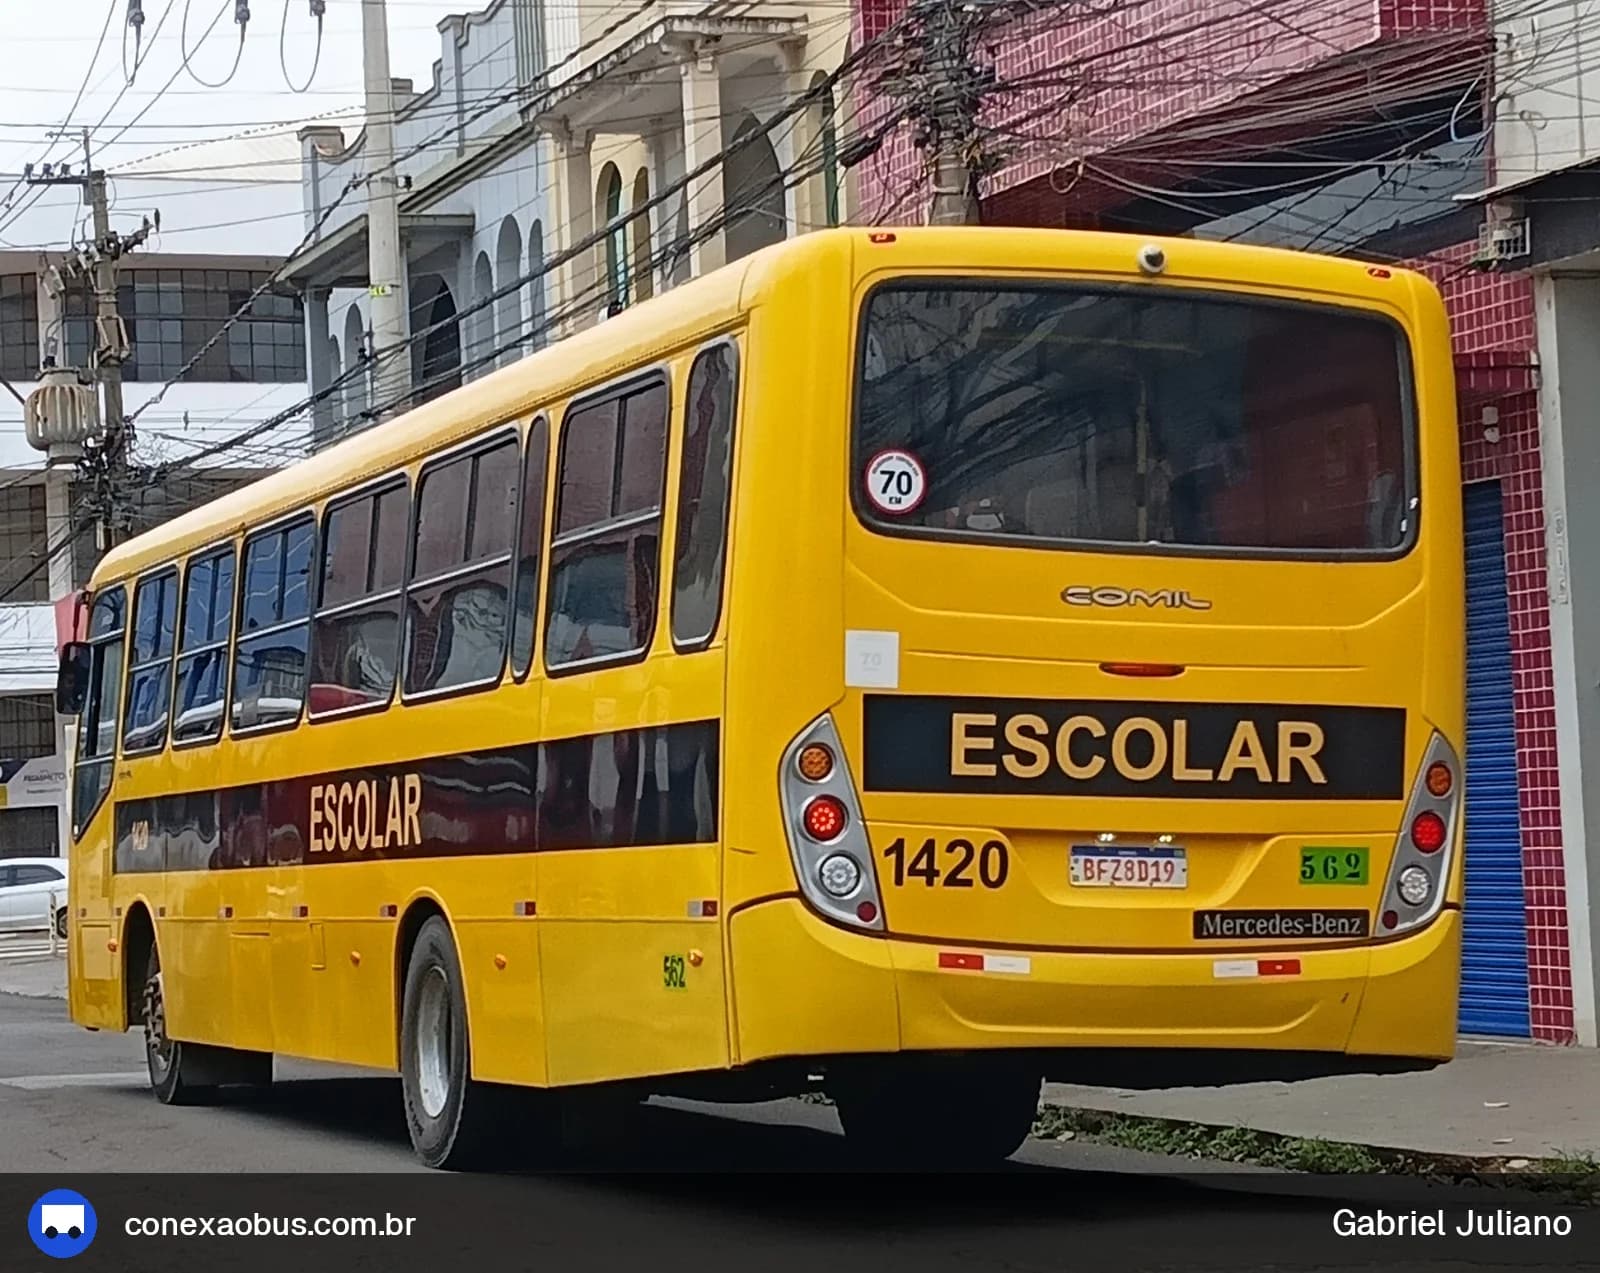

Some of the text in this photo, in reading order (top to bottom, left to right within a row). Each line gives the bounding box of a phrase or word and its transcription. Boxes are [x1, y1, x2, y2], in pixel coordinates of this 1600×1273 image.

[880, 470, 913, 496] 70
[889, 496, 902, 505] KM
[1060, 585, 1213, 610] COMIL
[950, 712, 1328, 784] ESCOLAR
[309, 773, 422, 852] ESCOLAR
[883, 837, 1009, 889] 1420
[1082, 858, 1176, 882] BFZ8D19
[1301, 852, 1361, 880] 562
[1202, 912, 1362, 936] Mercedes-Benz
[663, 955, 686, 988] 562
